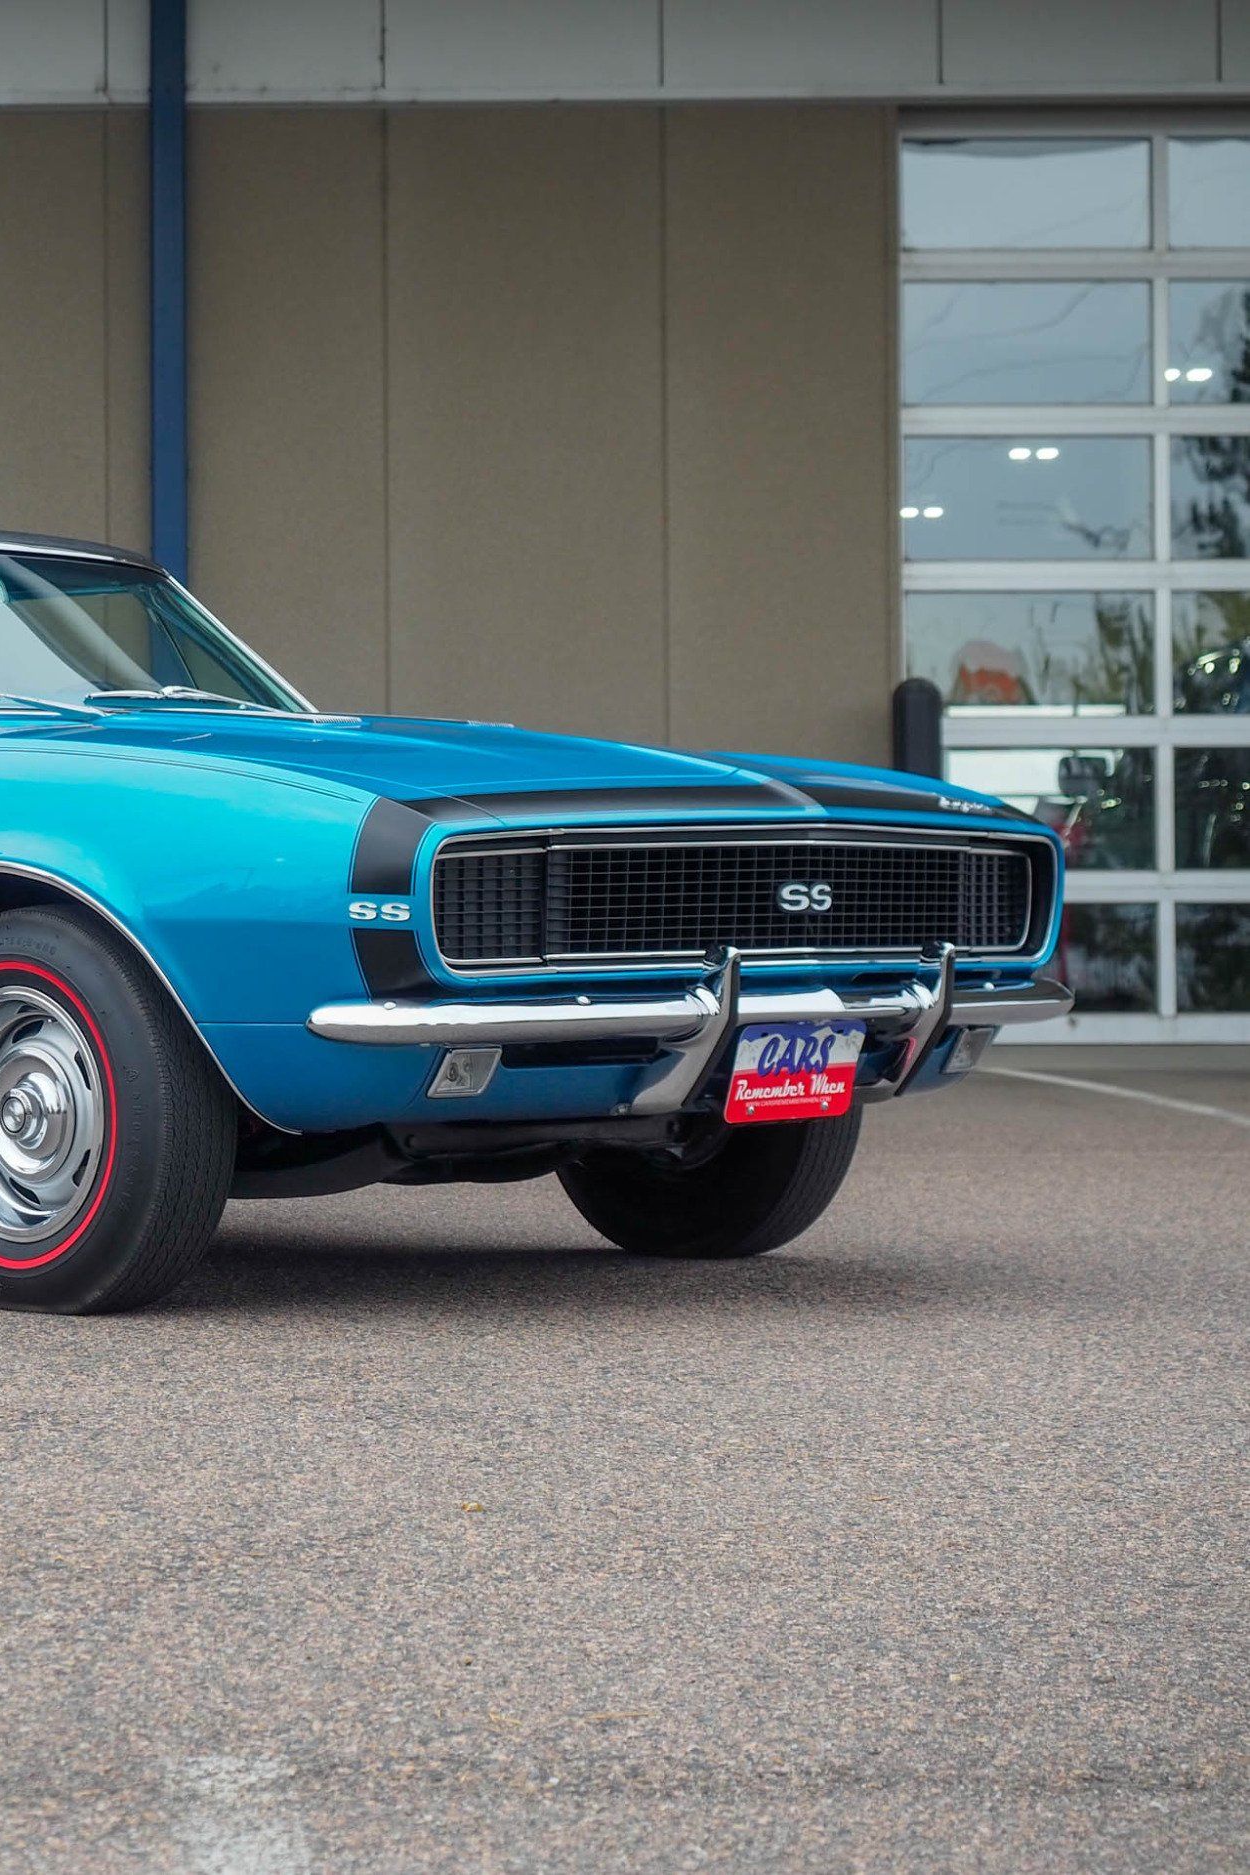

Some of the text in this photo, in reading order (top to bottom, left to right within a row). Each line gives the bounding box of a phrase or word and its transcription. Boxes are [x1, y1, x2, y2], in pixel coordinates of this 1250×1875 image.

[349, 901, 410, 920] SS
[780, 884, 832, 911] SS
[758, 1035, 836, 1077] CARS
[735, 1074, 845, 1101] Remember When
